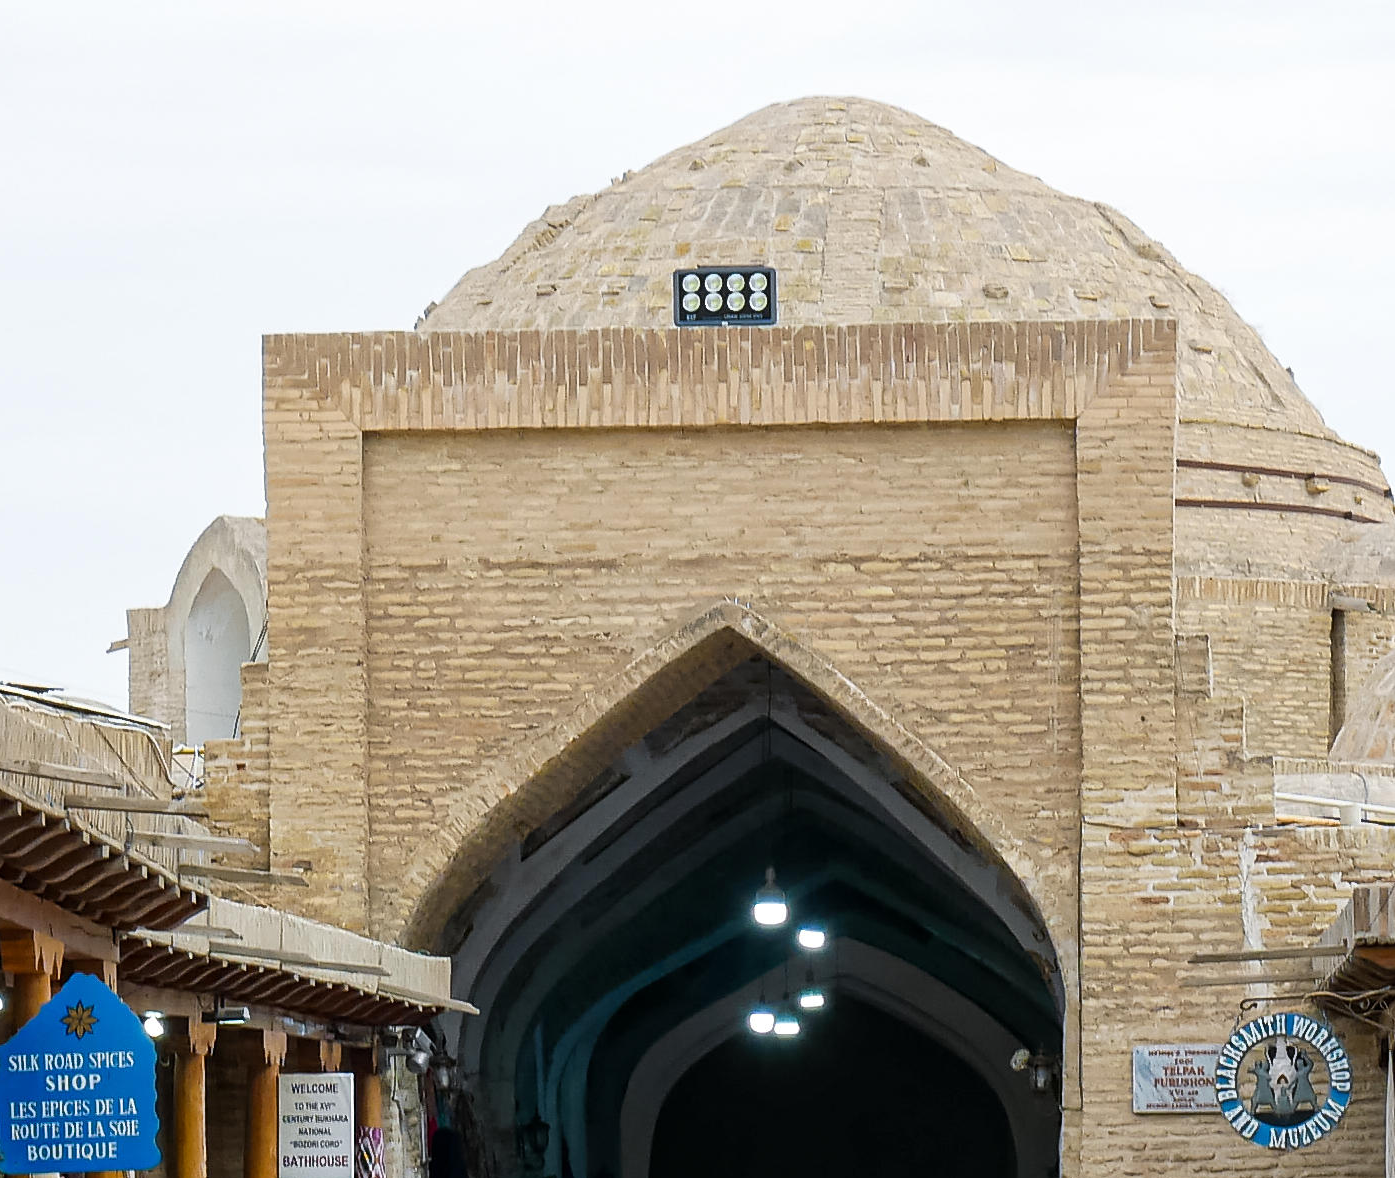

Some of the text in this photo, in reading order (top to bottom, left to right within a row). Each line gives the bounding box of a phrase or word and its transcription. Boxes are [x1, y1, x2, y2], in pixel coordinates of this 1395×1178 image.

[8, 1051, 135, 1072] SILK ROAD SPICES
[1217, 1014, 1352, 1103] BLACKSMITH WORKSHOP
[1162, 1066, 1205, 1076] TELPAK
[45, 1074, 102, 1092] SHOP
[291, 1082, 339, 1094] WELCOME
[10, 1098, 137, 1119] LES EPICES DE LA
[11, 1119, 140, 1140] ROUTE DE LA SOIE
[298, 1127, 332, 1136] NATIONAL
[1223, 1097, 1346, 1149] AND MUZEUM
[28, 1142, 118, 1161] BOUTIQUE
[282, 1155, 348, 1167] BATHHOUSE
